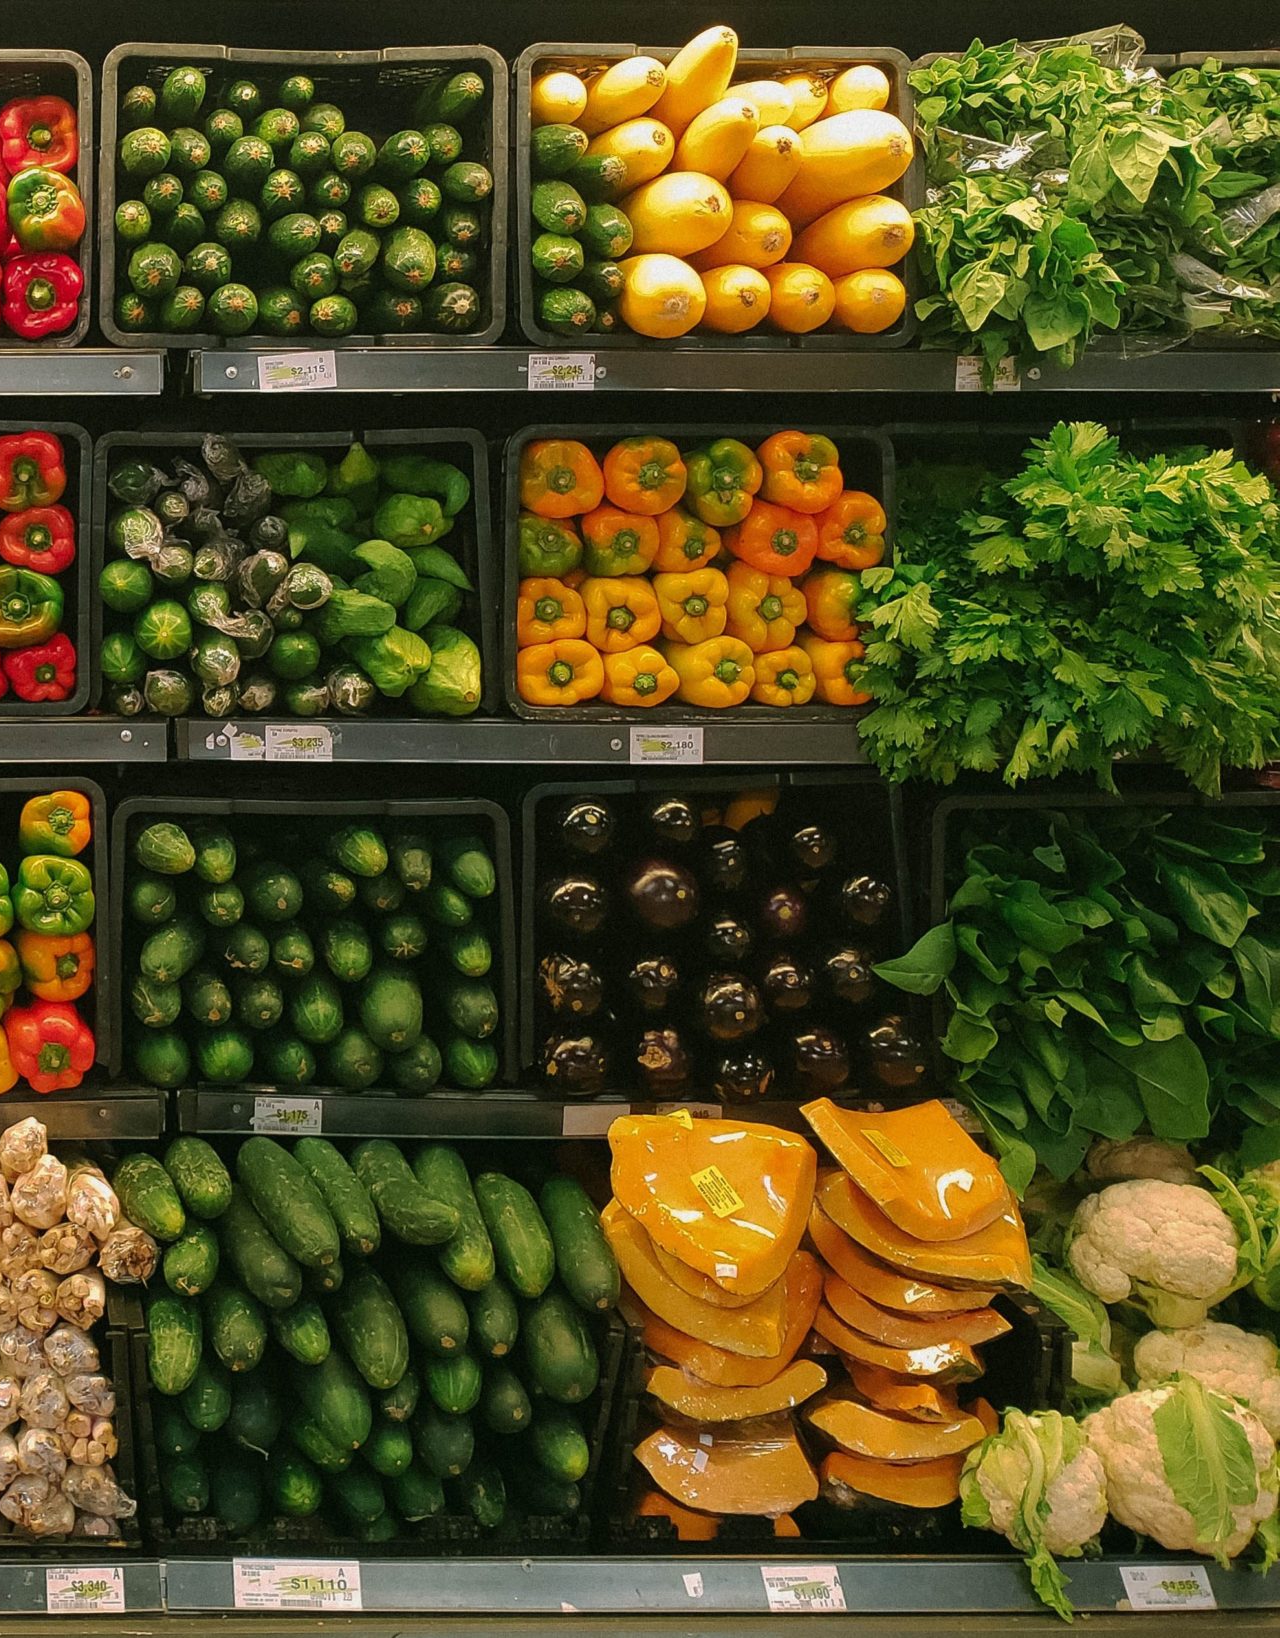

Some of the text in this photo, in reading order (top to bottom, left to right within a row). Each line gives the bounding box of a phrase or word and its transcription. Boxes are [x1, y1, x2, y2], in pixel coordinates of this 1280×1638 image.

[589, 356, 595, 365] A
[291, 364, 325, 375] $2,115
[552, 365, 583, 376] $2,245
[292, 737, 324, 748] $3,235
[313, 1101, 320, 1110] A
[113, 1568, 120, 1580] A
[338, 1568, 344, 1577] A
[71, 1580, 107, 1593] $3,340
[291, 1578, 347, 1591] $1,110
[833, 1576, 842, 1587] A
[1161, 1580, 1200, 1591] $4,555
[793, 1587, 830, 1600] $1,190
